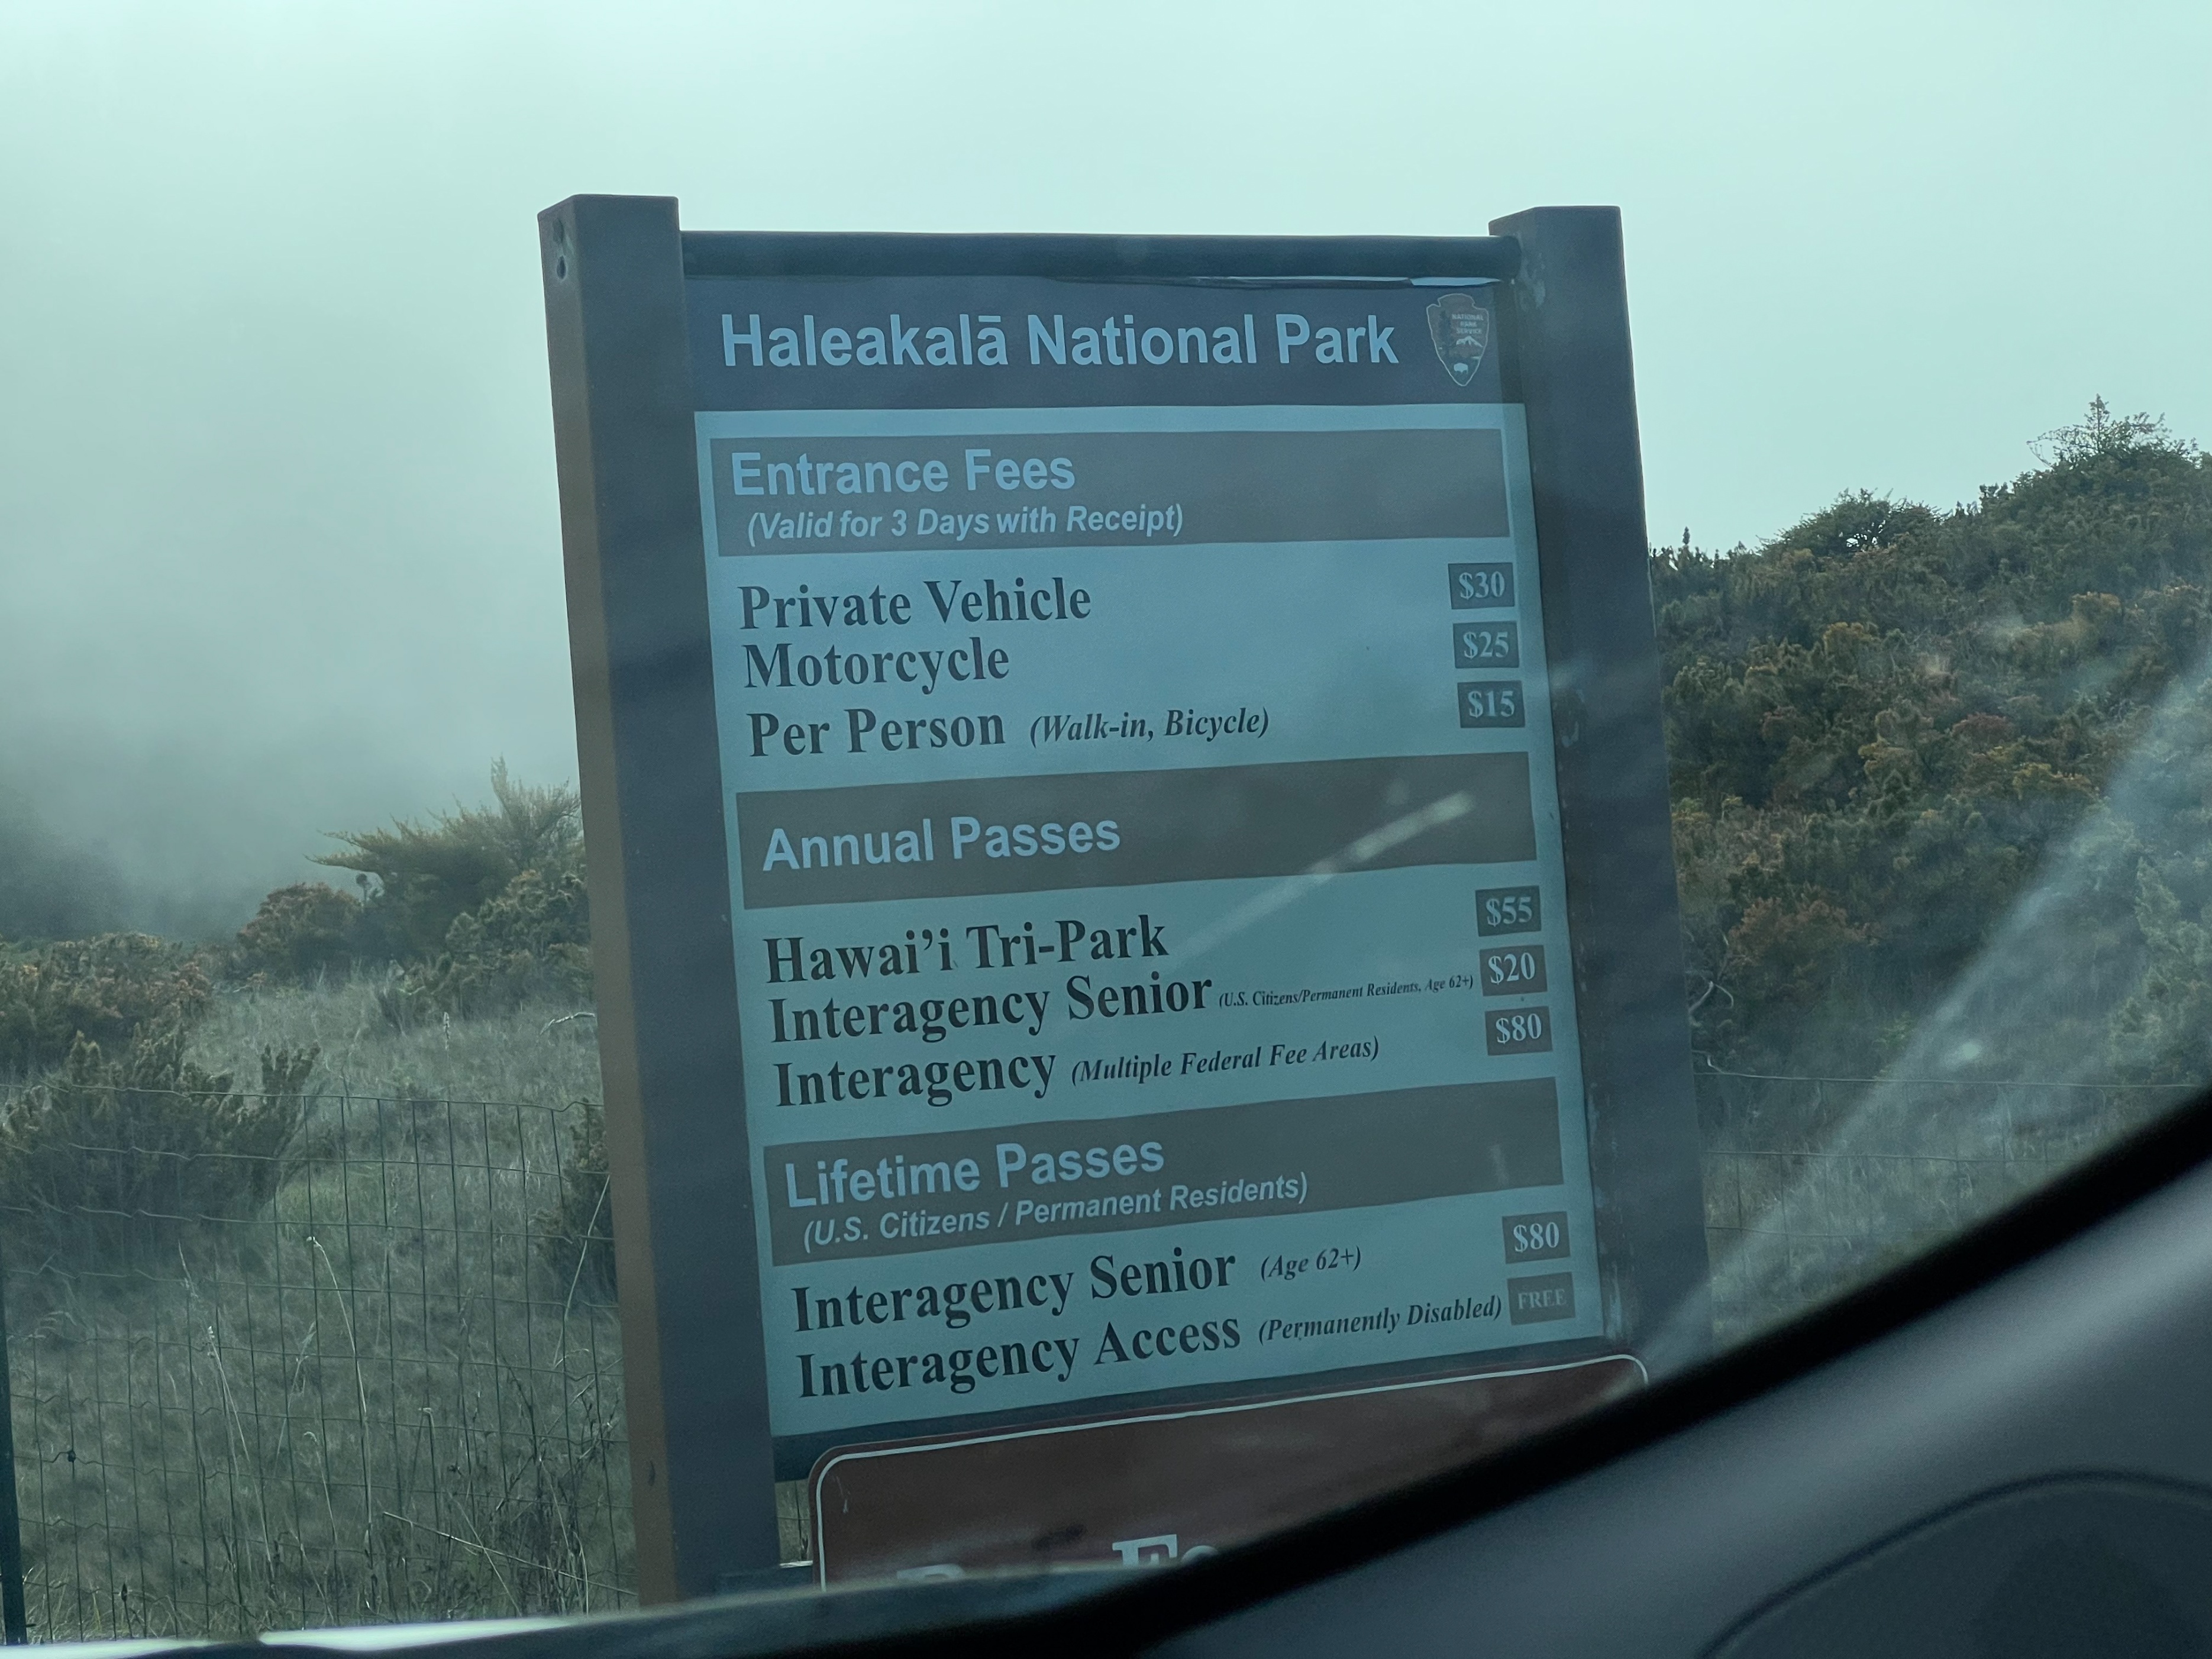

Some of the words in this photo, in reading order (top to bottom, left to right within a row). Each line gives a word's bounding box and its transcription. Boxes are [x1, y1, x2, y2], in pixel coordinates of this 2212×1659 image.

[721, 314, 1008, 366] Haleakalā
[1028, 314, 1257, 366] National
[1275, 314, 1399, 364] Park
[731, 451, 948, 495] Entrance
[965, 448, 1076, 490] Fees
[748, 511, 834, 547] (Valid
[839, 510, 882, 538] for
[891, 509, 908, 537] 3
[916, 508, 990, 541] Days
[996, 505, 1057, 534] with
[1067, 503, 1183, 537] Receipt)
[737, 583, 912, 630] Private
[923, 577, 1092, 624] Vehicle
[1458, 570, 1506, 600] $30
[743, 637, 1010, 695] Motorcycle
[1462, 631, 1509, 660] $25
[1467, 690, 1515, 718] $15
[747, 712, 830, 757] Per
[844, 708, 1006, 753] Person
[1030, 711, 1154, 748] (Walk-in,
[1164, 706, 1269, 742] Bicycle)
[762, 818, 934, 872] Annual
[950, 815, 1121, 860] Passes
[1486, 896, 1533, 927] $55
[965, 914, 1170, 969] Tri-Park
[1488, 951, 1535, 985] $20
[769, 990, 1050, 1043] Interagency
[1067, 970, 1212, 1021] Senior
[1219, 992, 1248, 1008] (U.S.
[1425, 978, 1445, 993] Age
[1449, 974, 1474, 989] 62+)
[1496, 1012, 1542, 1044] $80
[773, 1054, 1057, 1108] Interagency
[1071, 1053, 1172, 1086] (Multiple
[1180, 1046, 1261, 1075] Federal
[1269, 1044, 1307, 1066] Fee
[1312, 1035, 1379, 1063] Areas)
[785, 1154, 981, 1208] Lifetime
[995, 1141, 1165, 1189] Passes
[803, 1216, 868, 1254] (U.S.
[880, 1205, 990, 1239] Citizens
[997, 1202, 1009, 1228] /
[1015, 1187, 1162, 1225] Permanent
[1170, 1171, 1308, 1211] Residents)
[1513, 1221, 1560, 1254] $80
[791, 1270, 1074, 1332] Interagency
[1090, 1246, 1236, 1300] Senior
[1260, 1255, 1309, 1282] (Age
[1316, 1245, 1362, 1272] 62+)
[1517, 1288, 1568, 1310] FREE
[796, 1337, 1080, 1398] Interagency
[1094, 1318, 1241, 1366] Access
[1258, 1307, 1400, 1346] (Permanently
[1406, 1295, 1503, 1326] Disabled)
